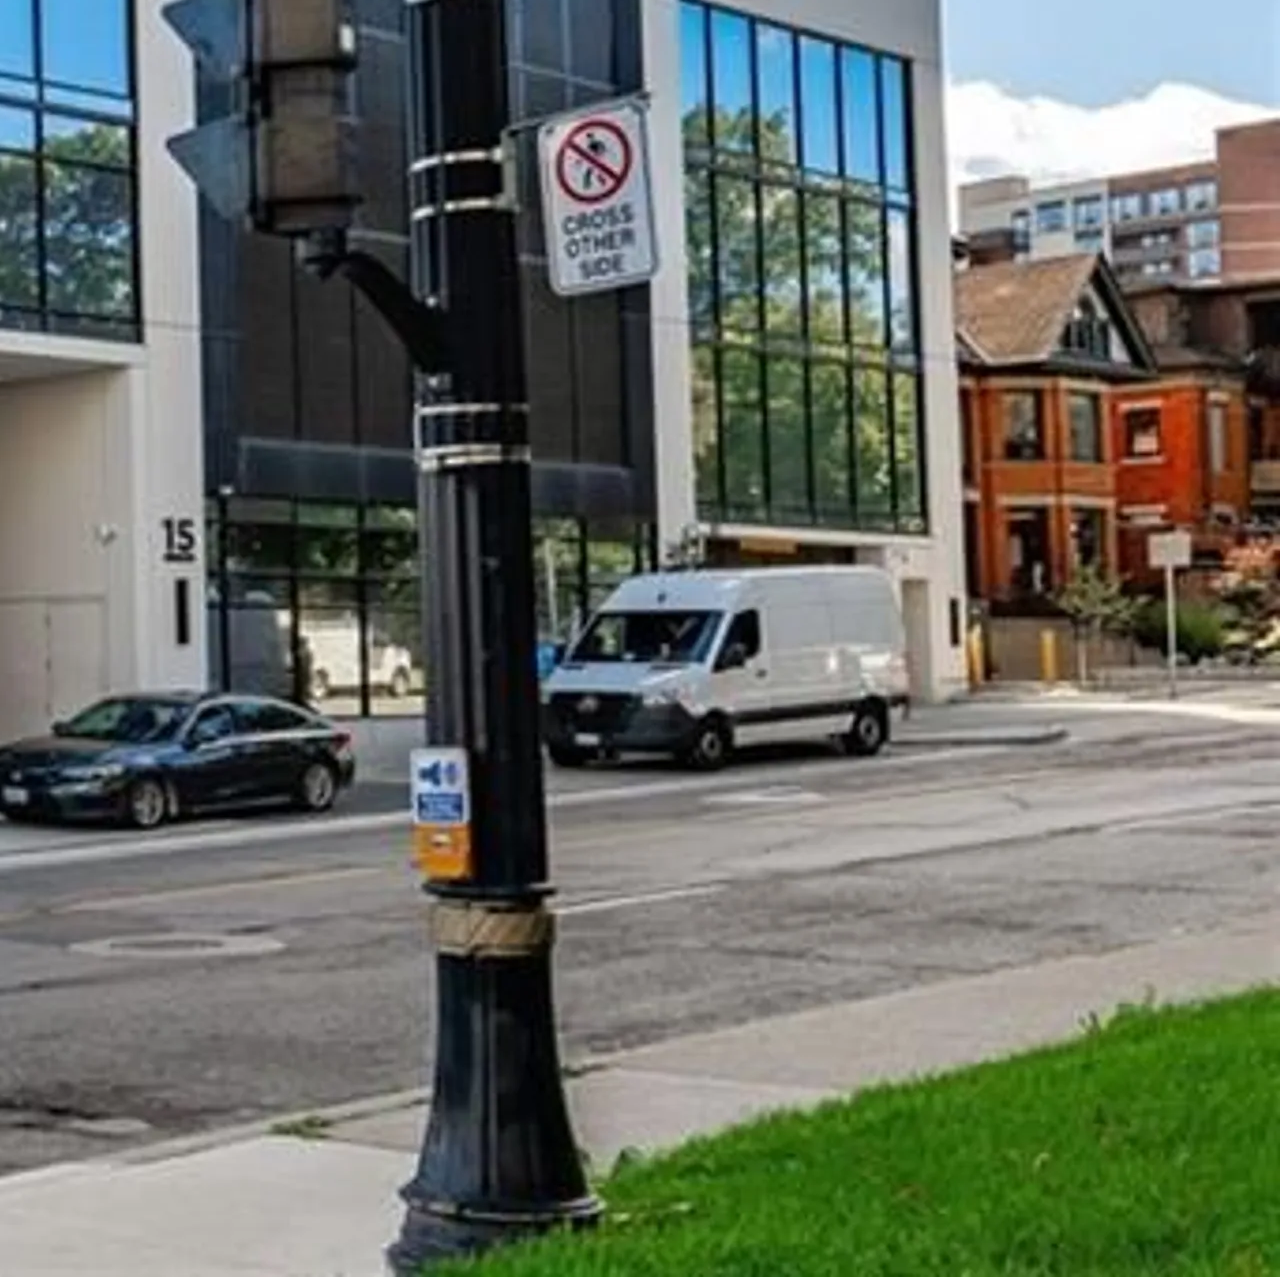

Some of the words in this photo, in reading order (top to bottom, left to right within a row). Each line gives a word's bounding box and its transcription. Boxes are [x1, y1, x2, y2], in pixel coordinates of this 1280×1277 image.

[563, 204, 634, 236] CROSS
[565, 228, 636, 259] OTHER
[162, 519, 195, 552] 15
